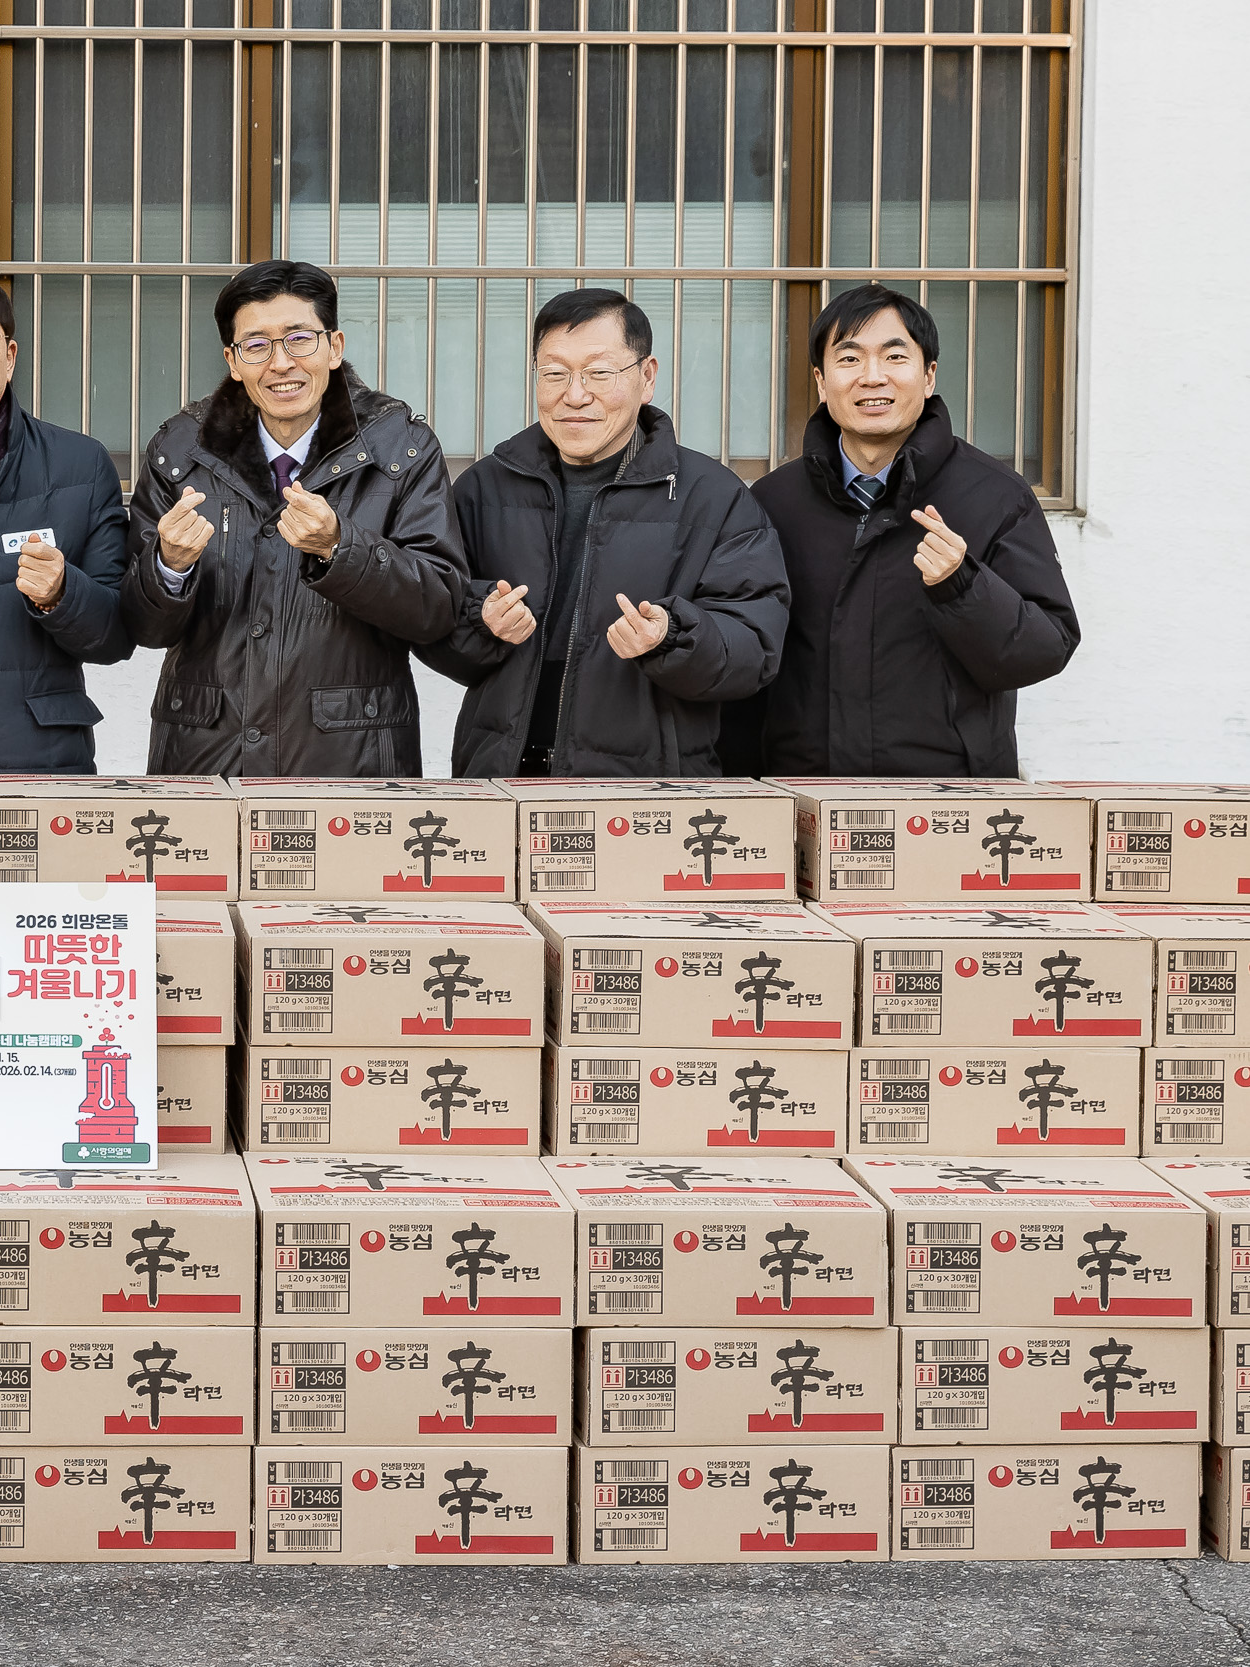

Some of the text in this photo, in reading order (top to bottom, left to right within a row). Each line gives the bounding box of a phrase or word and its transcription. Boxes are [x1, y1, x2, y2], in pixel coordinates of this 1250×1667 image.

[75, 819, 114, 834] 농심
[633, 820, 671, 835] 농심
[273, 834, 314, 848] 가3486
[684, 809, 740, 884] 辛
[852, 834, 893, 848] 가3486
[174, 848, 209, 862] 라면
[452, 849, 487, 863] 라면
[1029, 847, 1064, 861] 라면
[16, 914, 128, 930] 2026 희망온돌
[24, 933, 123, 965] 따뜻한
[682, 960, 723, 977] 농심
[7, 968, 136, 1000] 겨울나기
[288, 974, 330, 989] 가3486
[897, 976, 939, 991] 가3486
[475, 989, 512, 1004] 라면
[734, 951, 794, 1031] 辛
[1086, 991, 1123, 1006] 라면
[15, 1034, 73, 1047] 나눔캠페인
[677, 1070, 716, 1086] 농심
[966, 1069, 1006, 1085] 농심
[286, 1085, 328, 1100] 가3486
[884, 1084, 927, 1099] 가3486
[1019, 1059, 1107, 1138] 辛 라면
[472, 1100, 509, 1115] 라면
[729, 1061, 789, 1140] 辛
[91, 1147, 131, 1156] 사랑의열매
[389, 1224, 433, 1232] 인생을 맛있게
[69, 1231, 112, 1248] 농심
[389, 1233, 433, 1251] 농심
[702, 1234, 745, 1251] 농심
[126, 1220, 190, 1305] 辛
[301, 1250, 347, 1266] 가3486
[446, 1222, 541, 1308] 辛 라면
[760, 1223, 824, 1308] 辛
[933, 1250, 979, 1266] 가3486
[1133, 1267, 1172, 1283] 라면
[70, 1353, 113, 1370] 농심
[714, 1351, 757, 1368] 농심
[297, 1370, 343, 1386] 가3486
[771, 1340, 834, 1424] 辛
[941, 1367, 987, 1383] 가3486
[127, 1341, 192, 1428] 辛
[1139, 1381, 1178, 1397] 라면
[498, 1385, 537, 1401] 라면
[63, 1468, 107, 1485] 농심
[706, 1470, 750, 1487] 농심
[121, 1457, 185, 1542] 辛
[294, 1489, 340, 1505] 가3486
[763, 1459, 827, 1544] 辛
[926, 1486, 972, 1502] 가3486
[494, 1505, 533, 1521] 라면
[1127, 1500, 1166, 1516] 라면
